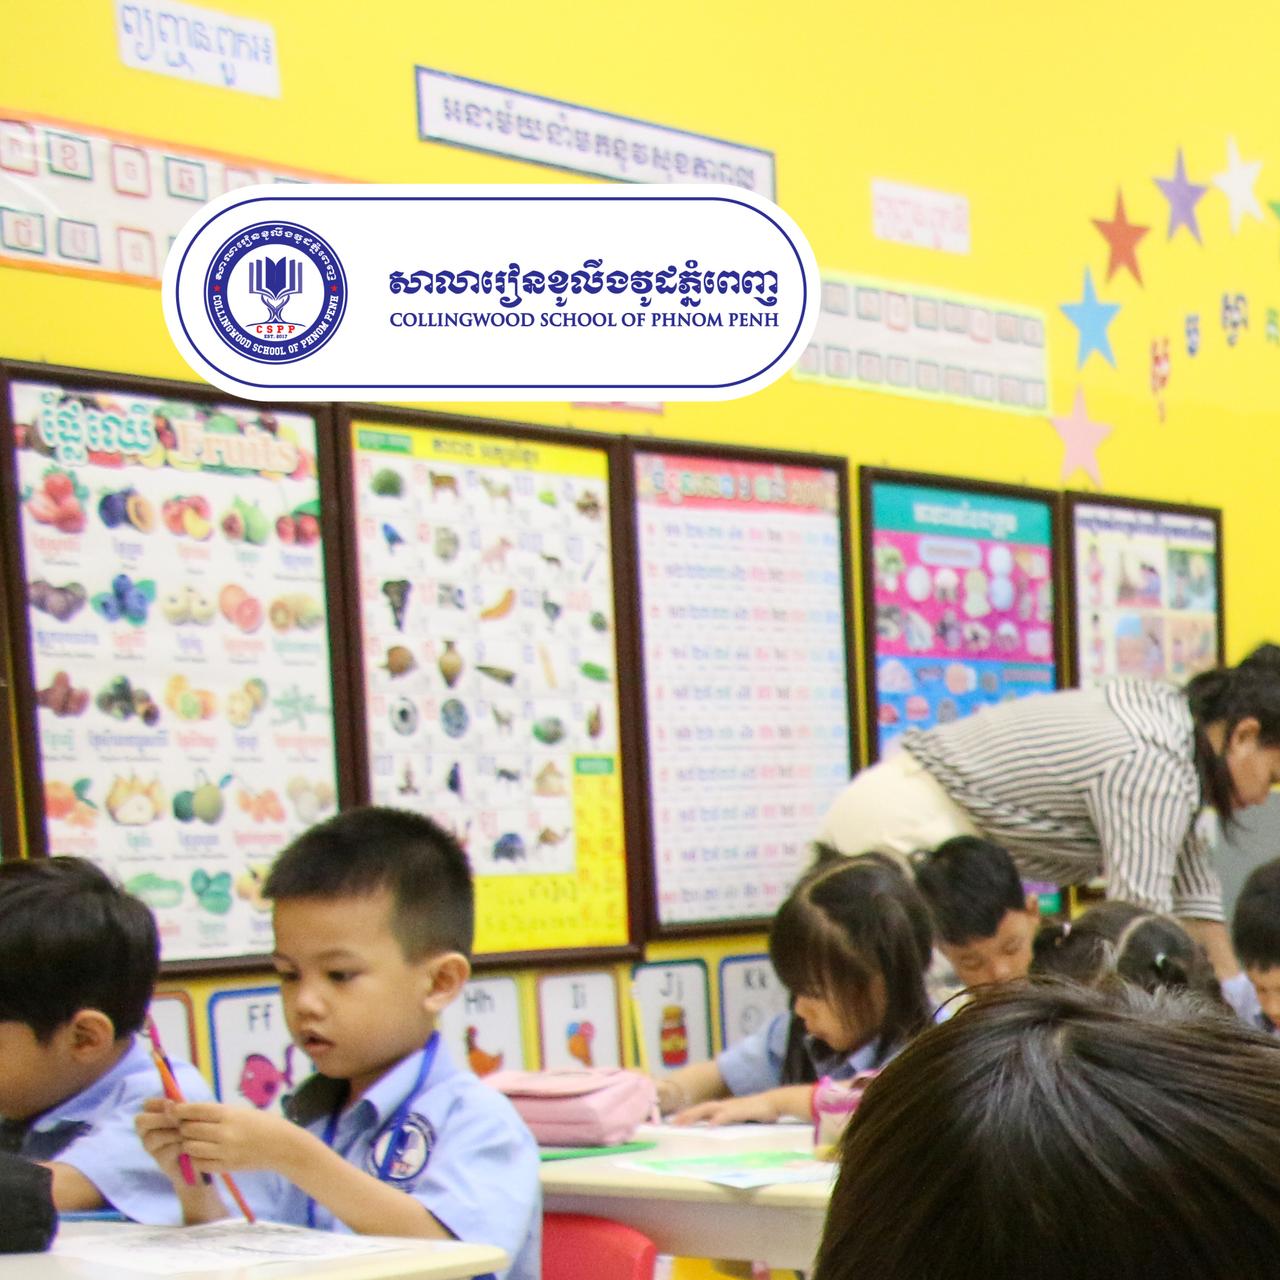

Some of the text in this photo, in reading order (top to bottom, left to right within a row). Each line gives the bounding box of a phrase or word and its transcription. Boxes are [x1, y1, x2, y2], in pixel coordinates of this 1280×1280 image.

[175, 418, 297, 473] Fruits
[660, 973, 684, 1001] Jj
[743, 968, 769, 990] Kk
[463, 991, 496, 1015] Hh
[247, 1004, 273, 1030] Ff
